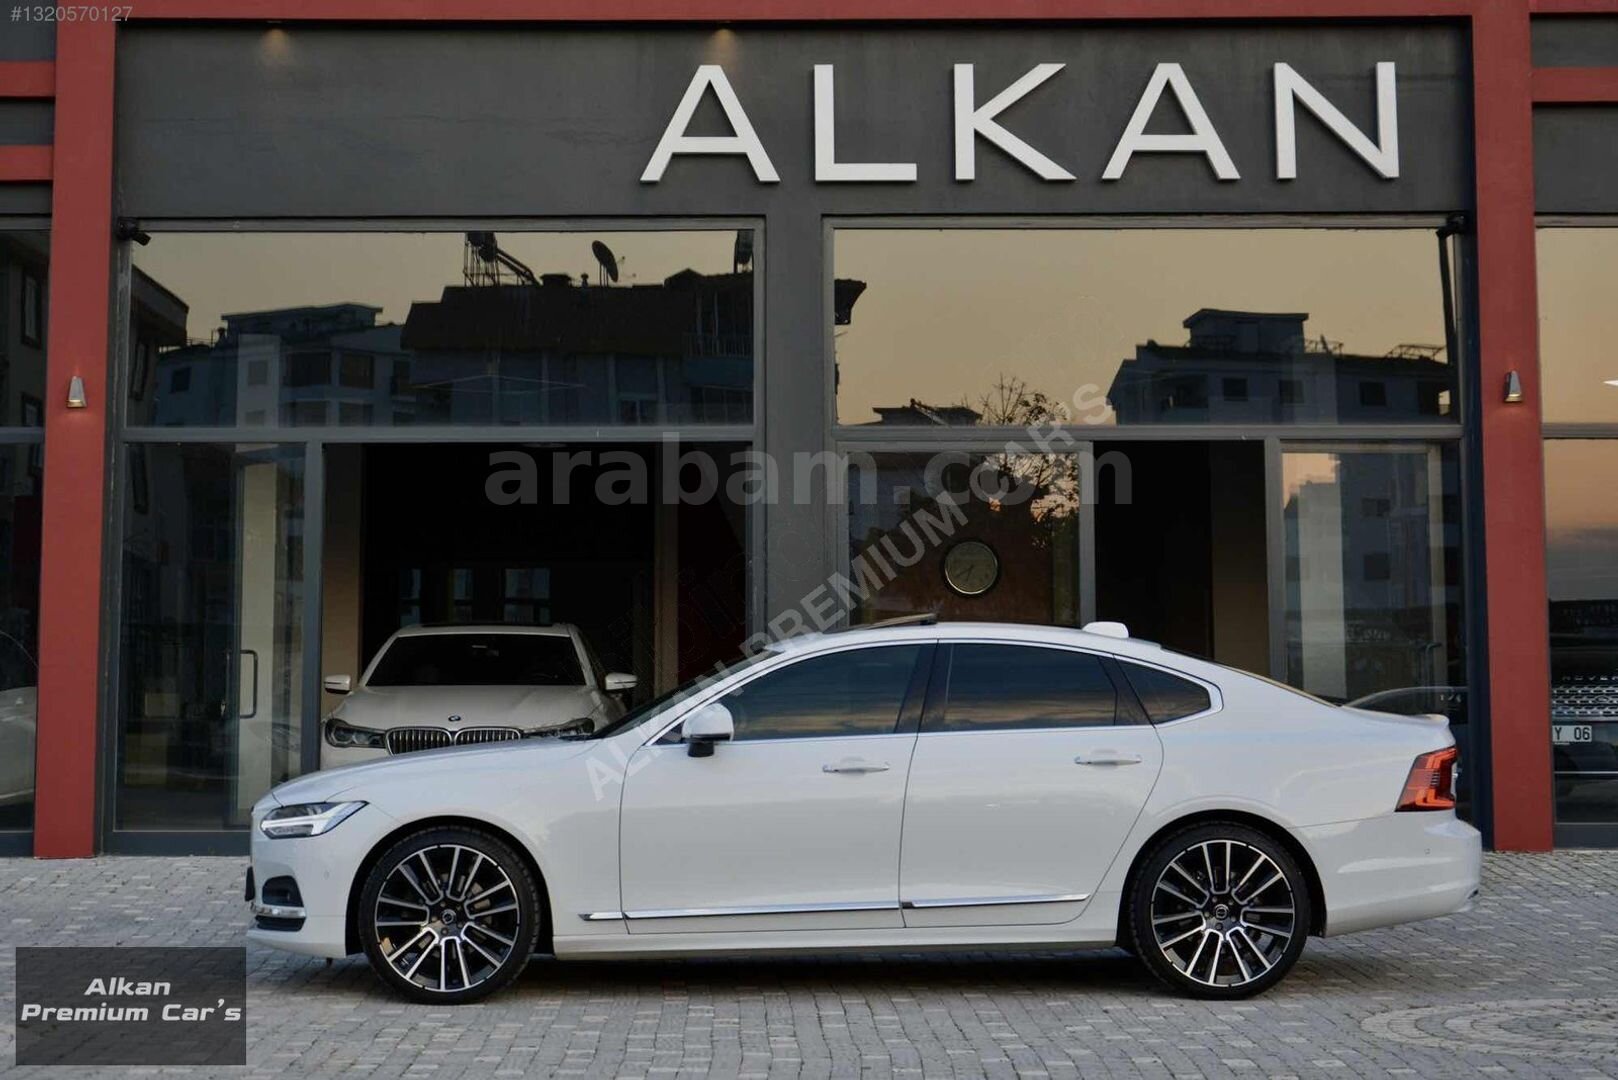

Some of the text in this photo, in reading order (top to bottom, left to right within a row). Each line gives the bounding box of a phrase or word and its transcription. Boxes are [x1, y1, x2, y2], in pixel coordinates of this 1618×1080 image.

[640, 62, 1400, 183] ALKAN
[1554, 727, 1590, 740] Y 06
